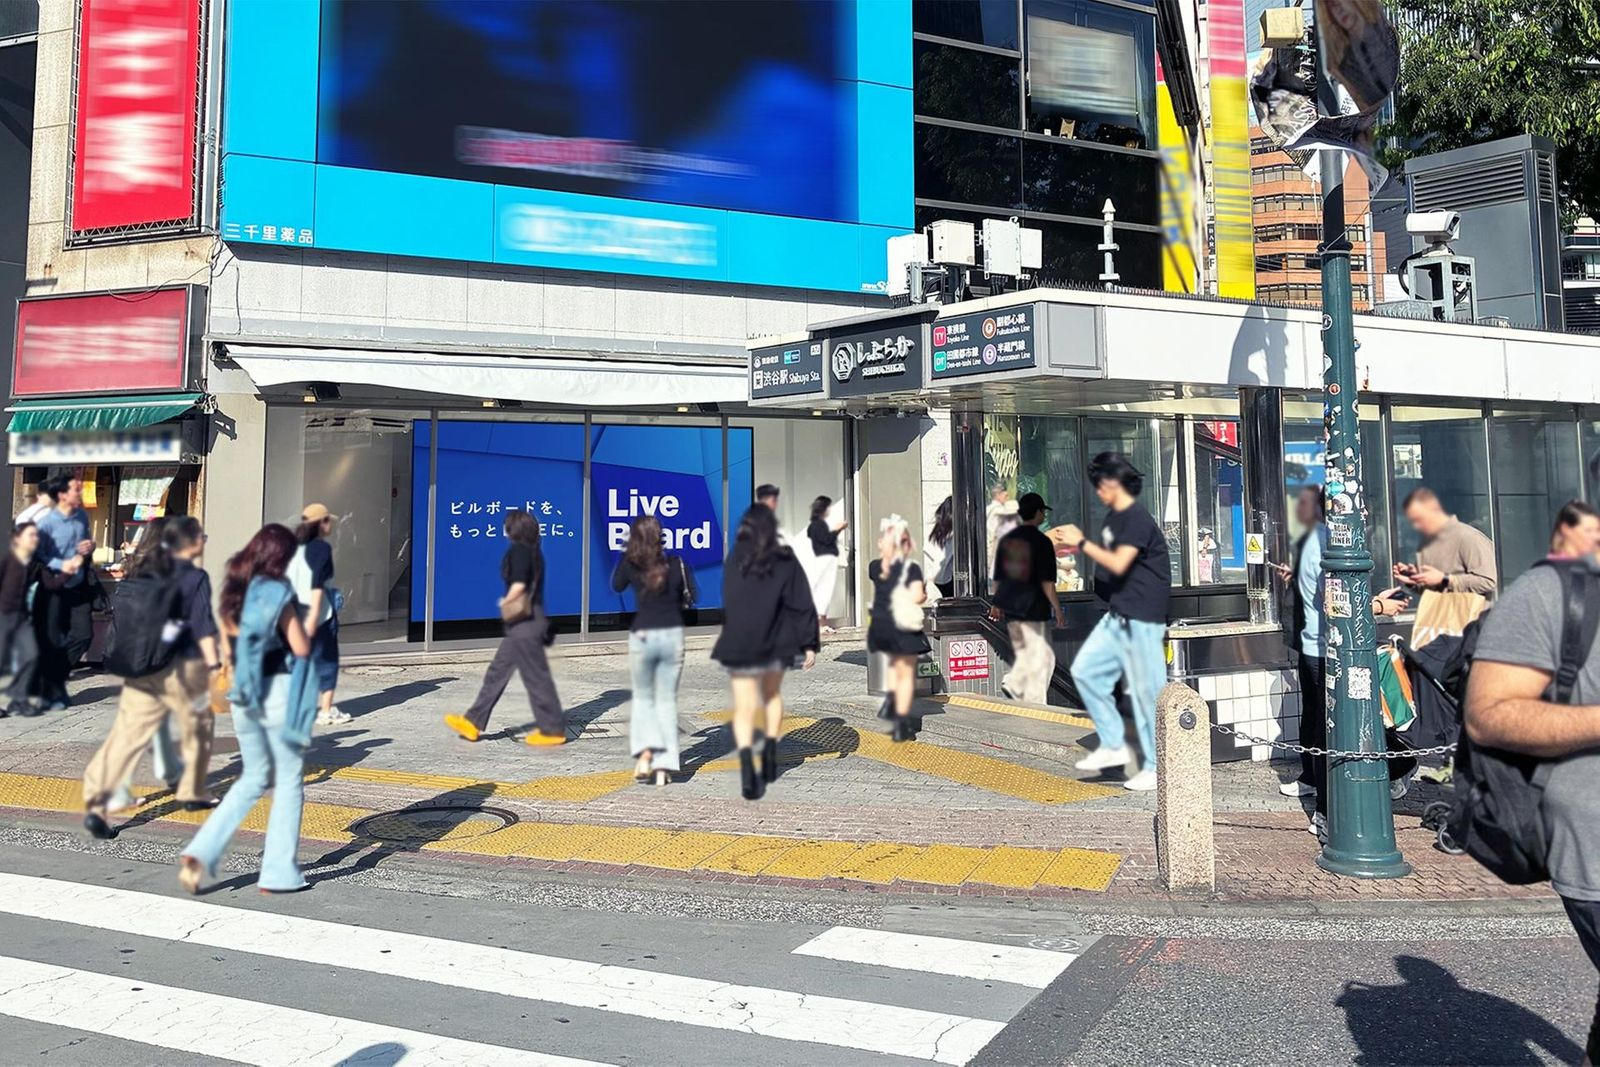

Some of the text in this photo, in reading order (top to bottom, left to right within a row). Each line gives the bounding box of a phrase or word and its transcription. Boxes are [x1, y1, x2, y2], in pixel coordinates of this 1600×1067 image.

[224, 223, 314, 244] 三千里薬品
[763, 369, 788, 387] 渋谷駅
[788, 372, 810, 385] Shibuya
[450, 500, 562, 515] ビルボードを、
[608, 488, 680, 517] Live
[608, 521, 711, 552] Bard
